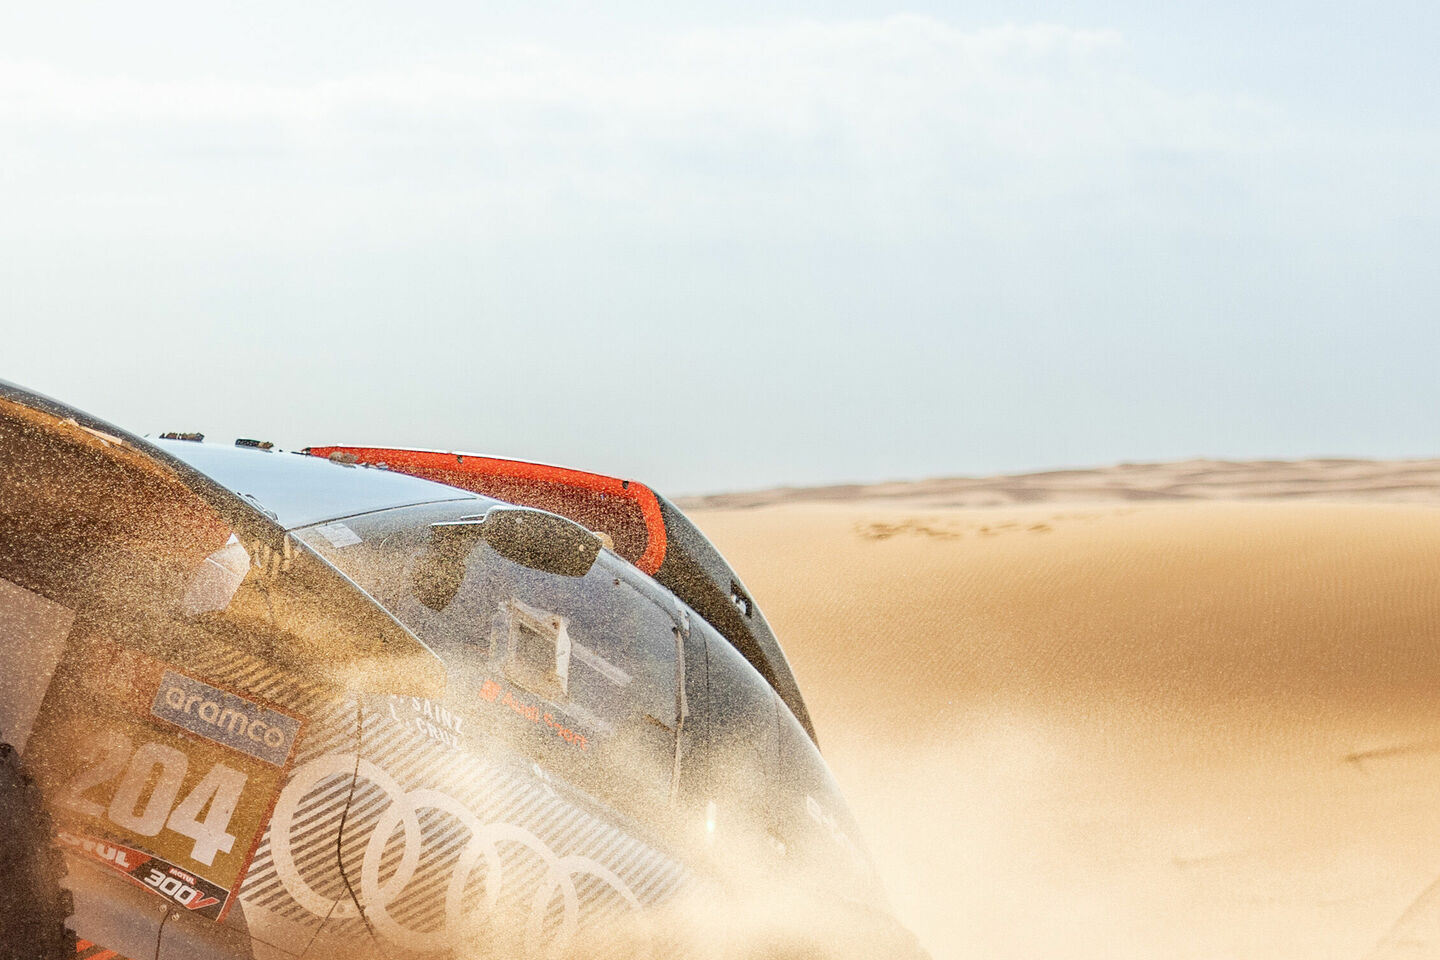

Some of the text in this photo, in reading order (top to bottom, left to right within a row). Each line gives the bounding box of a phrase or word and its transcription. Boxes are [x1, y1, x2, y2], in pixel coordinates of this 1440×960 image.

[164, 686, 285, 749] aramco
[54, 730, 249, 867] 204
[60, 832, 130, 869] OTUL
[144, 868, 221, 911] 300V
[169, 867, 196, 885] MOTUL
